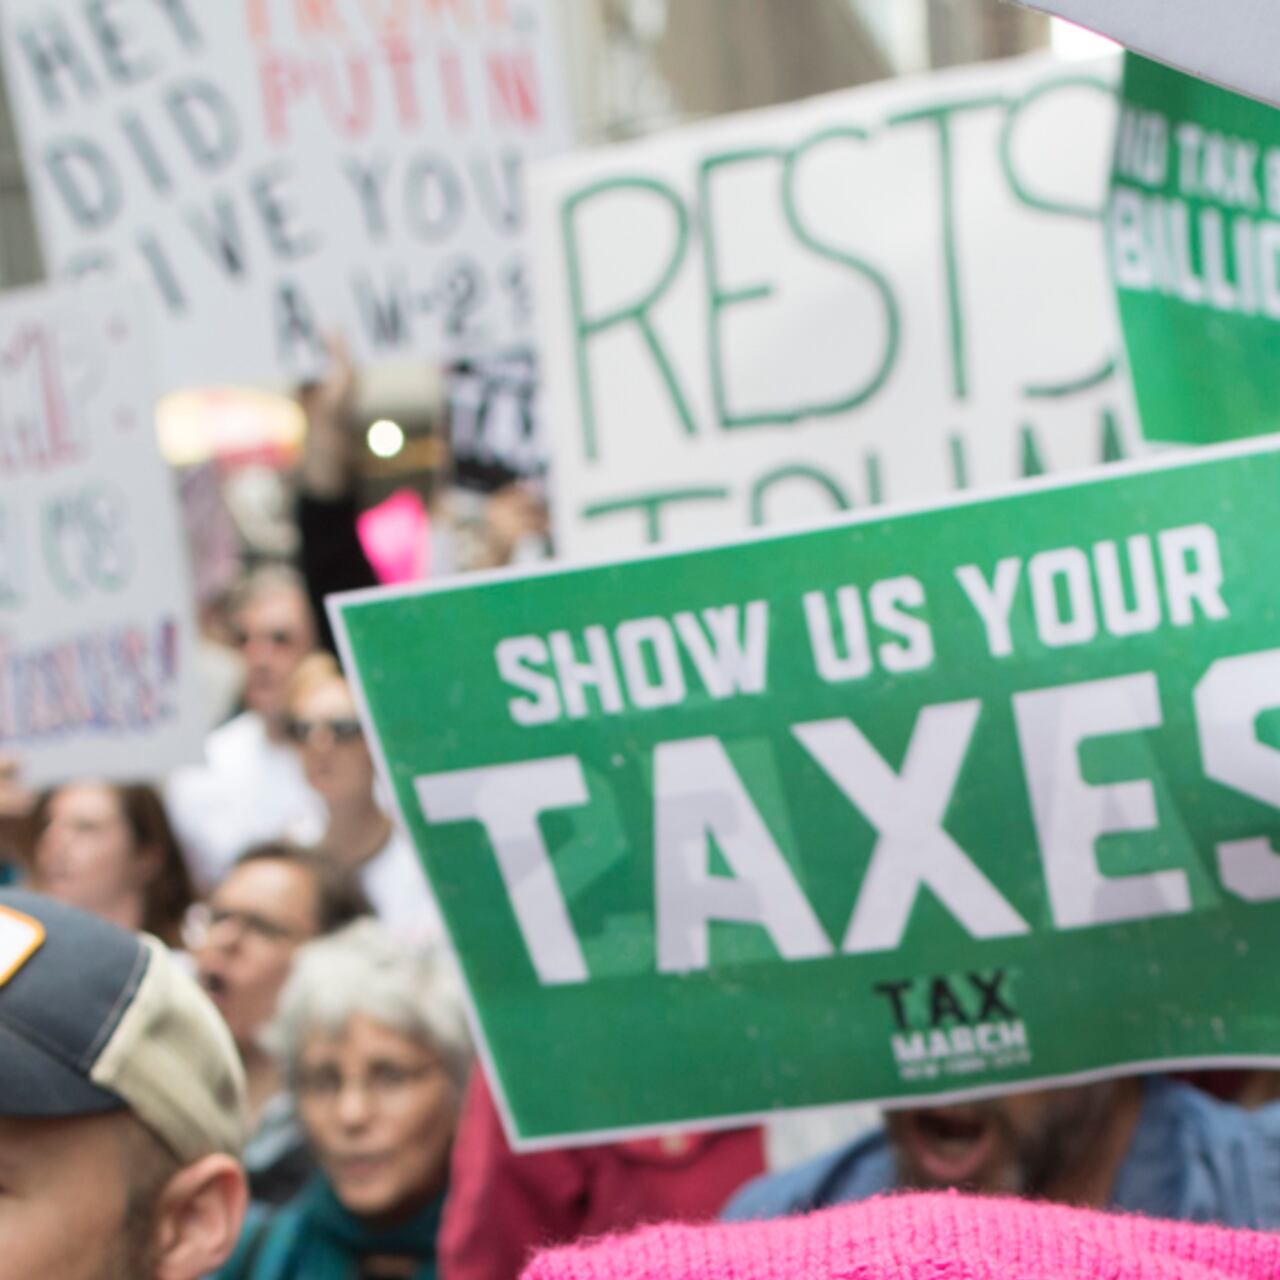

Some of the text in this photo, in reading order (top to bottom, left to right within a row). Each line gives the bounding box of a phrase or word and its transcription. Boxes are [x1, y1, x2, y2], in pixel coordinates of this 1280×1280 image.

[45, 35, 542, 232] DID PUTIN
[1175, 122, 1261, 212] TAX
[65, 147, 527, 318] IVE YOU
[493, 523, 1230, 726] SHOW US YOUR
[871, 966, 1019, 1031] TAX
[890, 1019, 1026, 1062] MARCH
